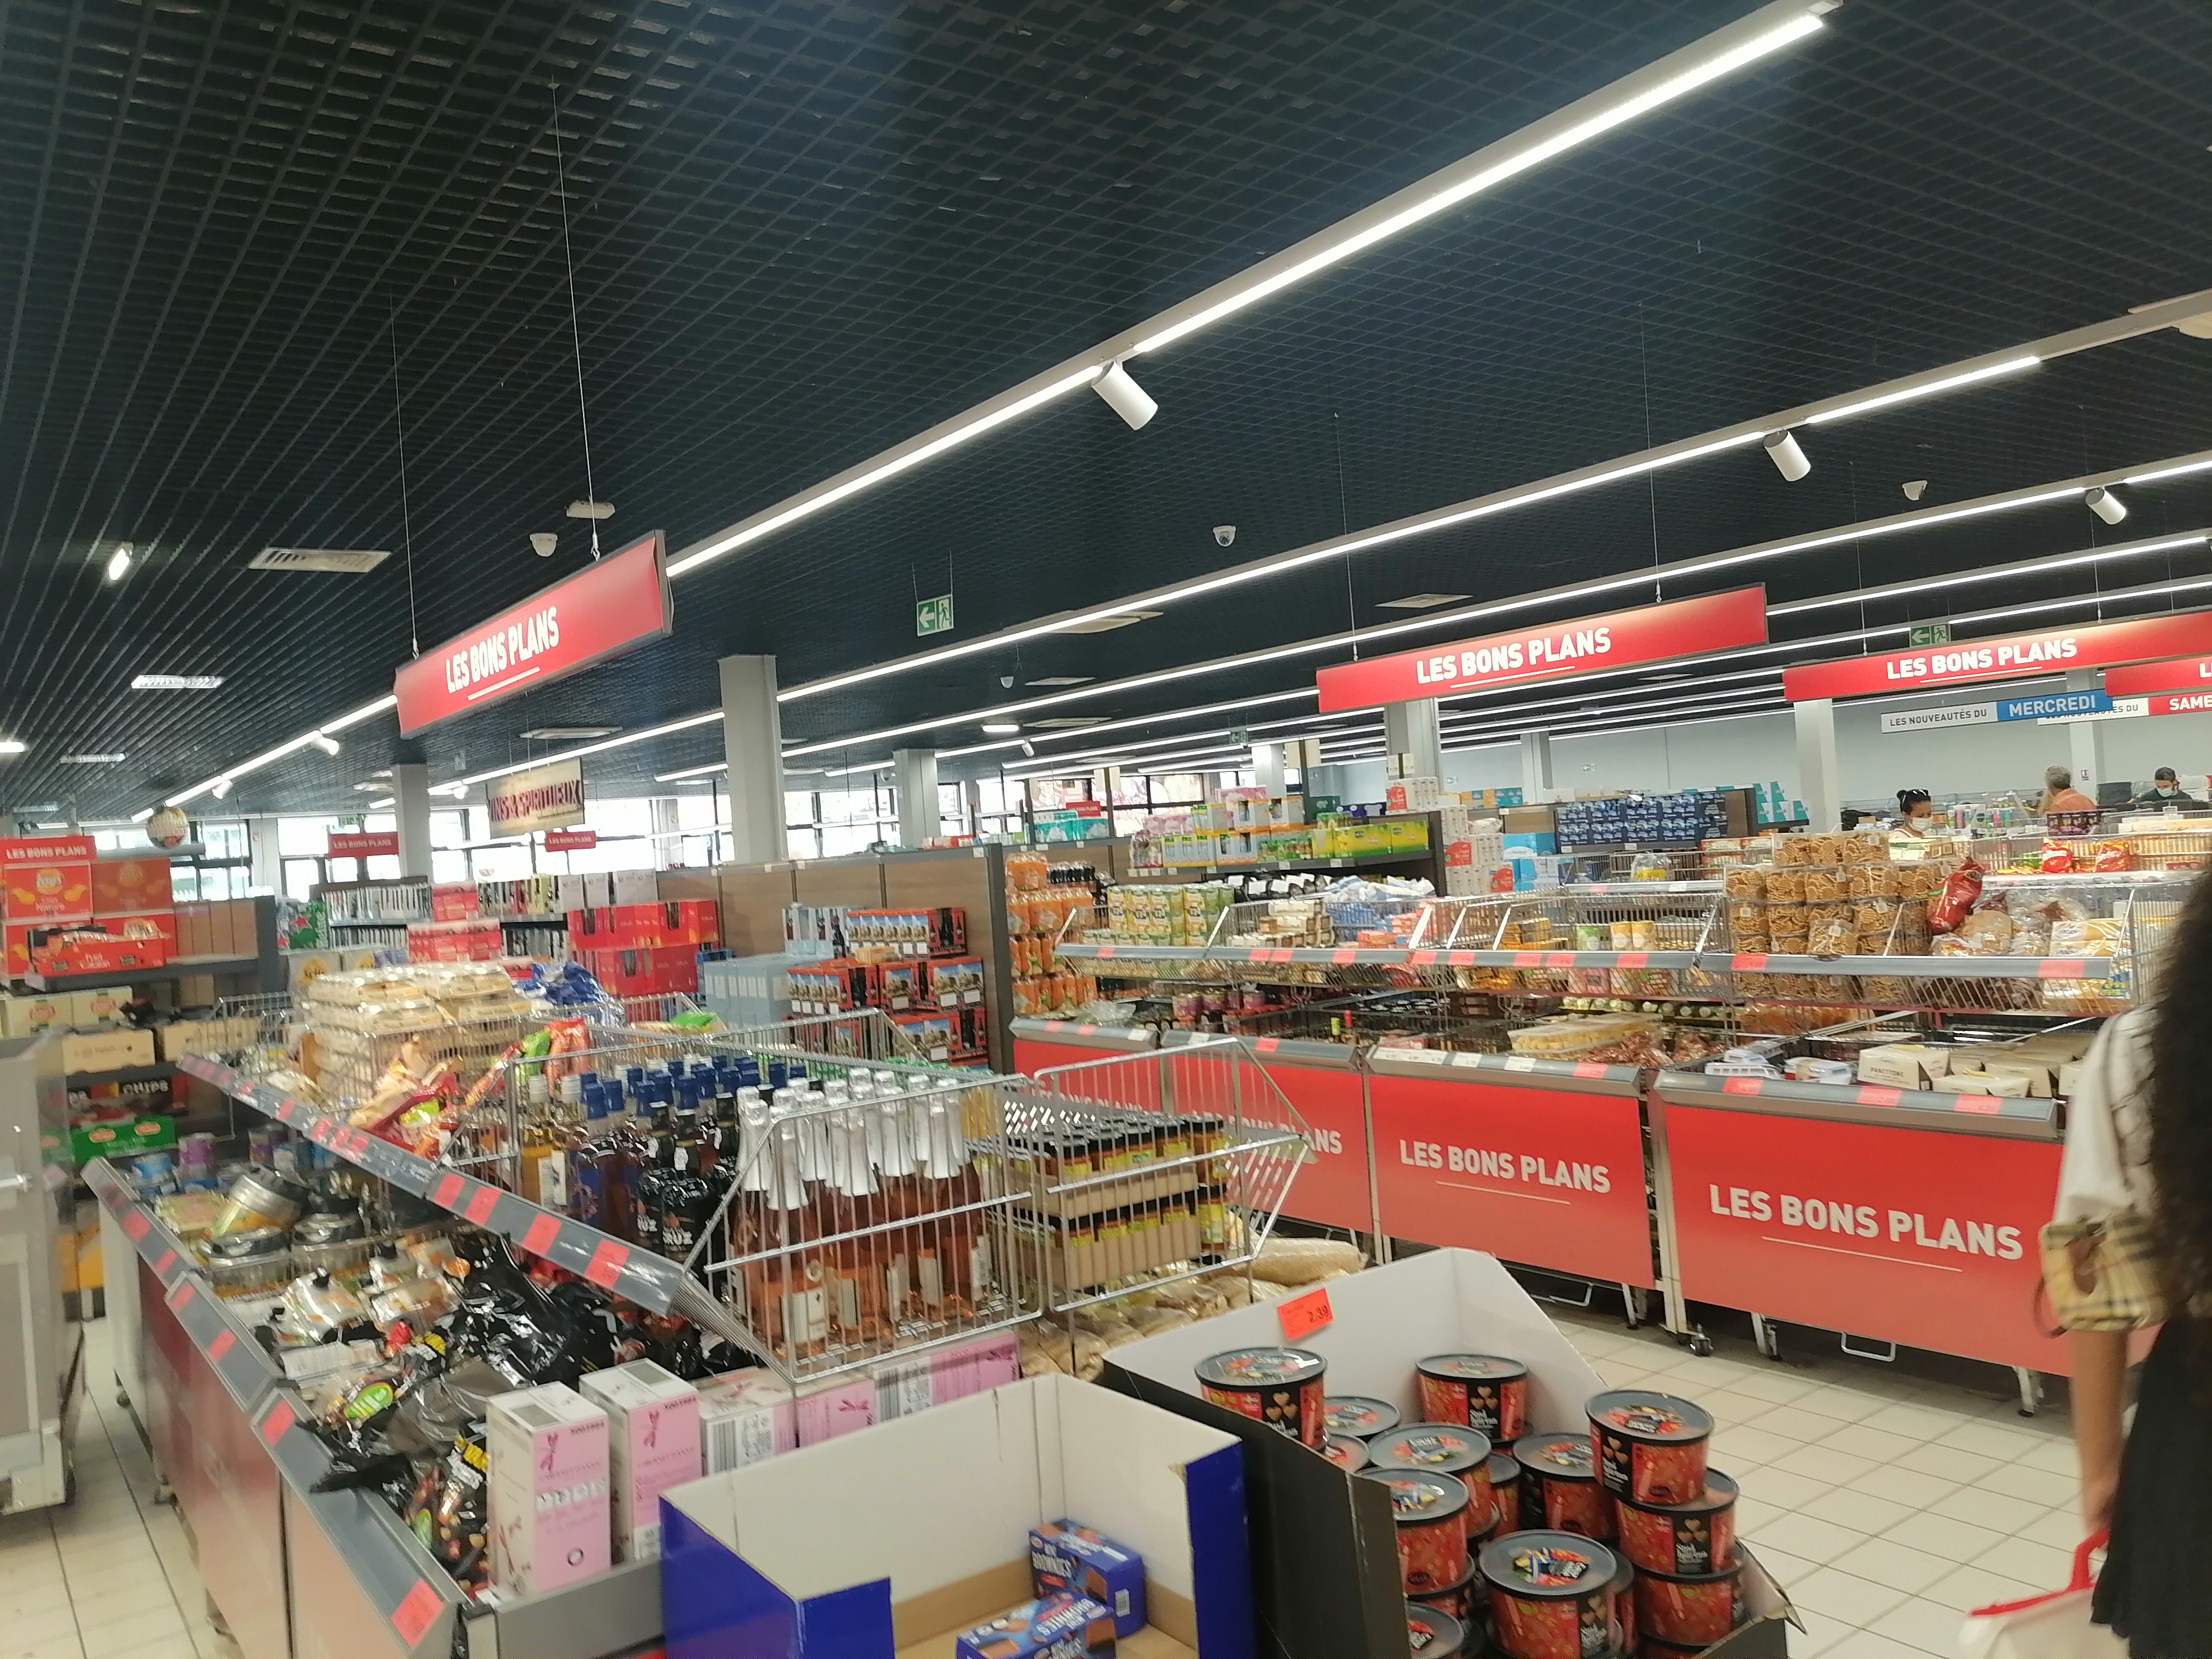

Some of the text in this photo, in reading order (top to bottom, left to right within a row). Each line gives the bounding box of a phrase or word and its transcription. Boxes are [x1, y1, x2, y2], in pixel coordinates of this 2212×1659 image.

[446, 606, 559, 693] LES BONS PLANS
[1417, 627, 1611, 684] LES BONS PLANS
[1887, 638, 2078, 680] LES BONS PLANS
[1890, 717, 1907, 727] LES
[1909, 708, 1972, 724] NOUVEAUTÉS
[1974, 708, 1987, 718] DU
[2009, 695, 2096, 717] MERCREDI
[2126, 704, 2138, 712] DU
[6, 845, 87, 859] LES BONS PLANS
[333, 841, 347, 849] LES
[368, 838, 392, 847] PLANS
[1400, 1139, 1611, 1193] LES BONS PLANS
[1709, 1184, 2023, 1260] LES BONS PLANS
